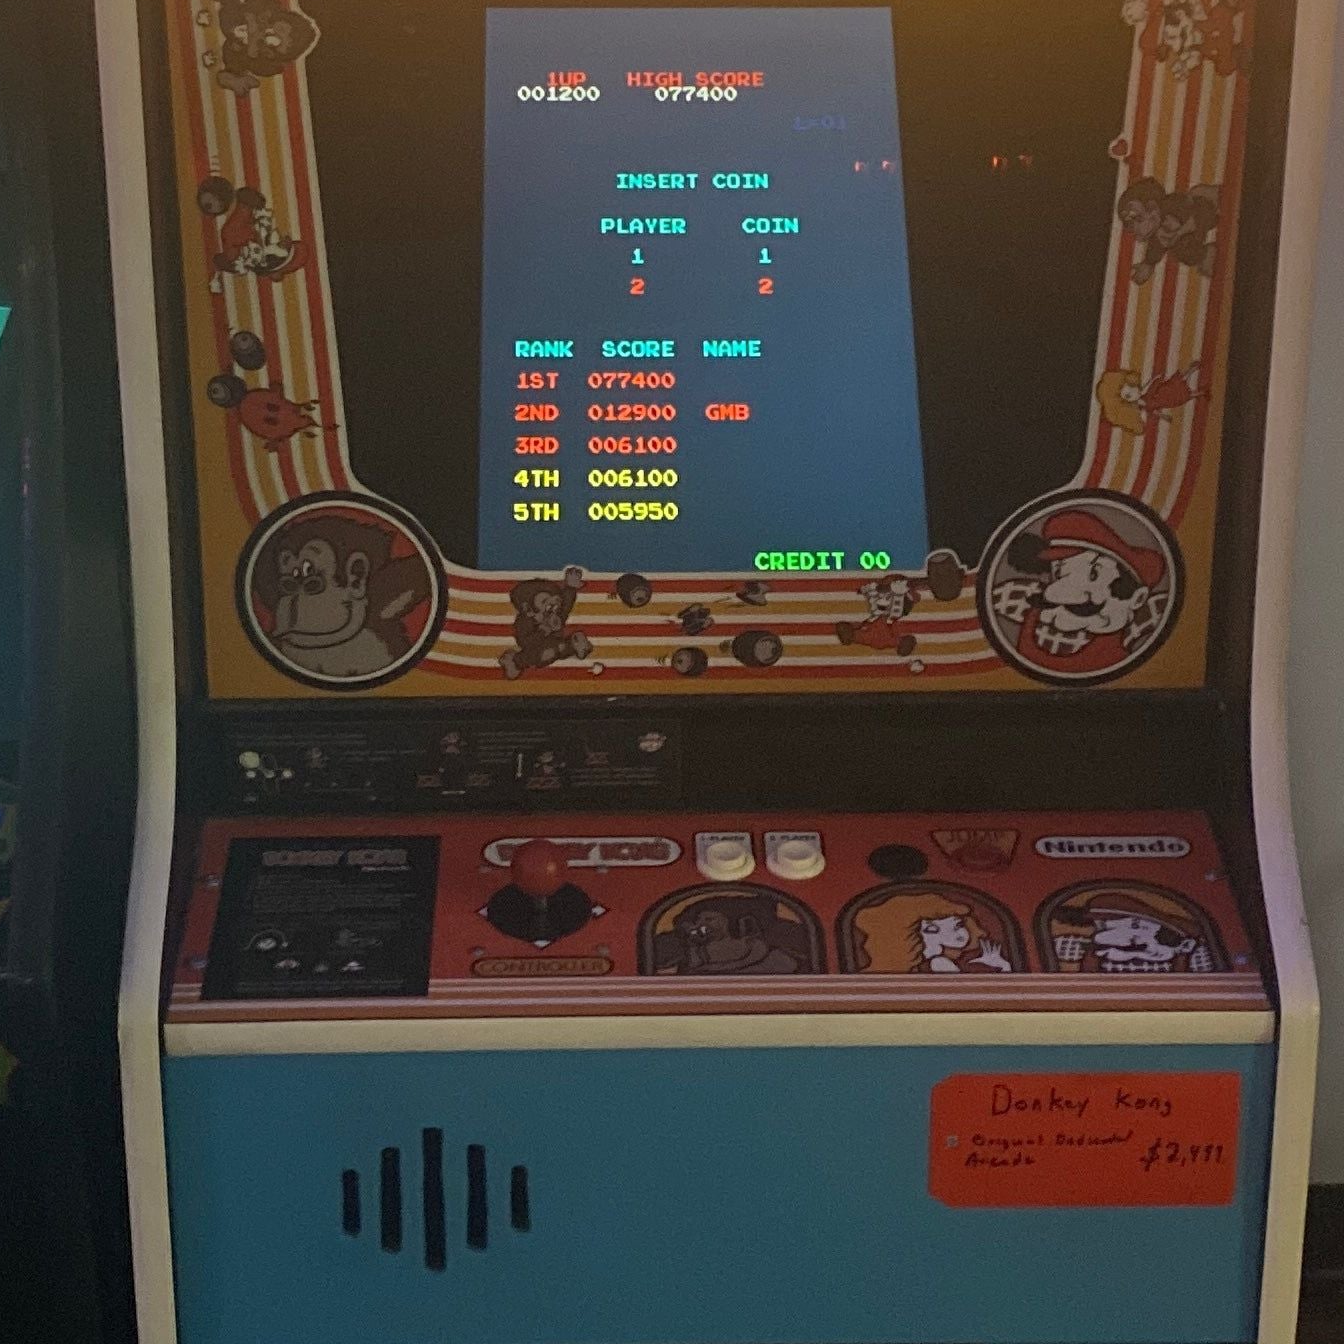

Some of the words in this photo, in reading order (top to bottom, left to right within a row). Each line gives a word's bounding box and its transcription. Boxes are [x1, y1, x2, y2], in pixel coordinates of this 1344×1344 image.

[546, 72, 587, 86] 1UP
[626, 72, 679, 87] HIGH
[695, 72, 764, 87] SCORE
[517, 86, 601, 102] 001200
[654, 86, 738, 102] 077400
[616, 173, 699, 189] INSERT
[712, 173, 769, 189] COIN
[600, 217, 686, 234] PLAYER
[742, 217, 799, 234] COIN
[631, 248, 645, 265] 1
[758, 248, 772, 264] 1
[629, 278, 645, 295] 2
[758, 278, 774, 295] 2
[514, 340, 574, 358] RANK
[601, 340, 676, 358] SCORE
[702, 340, 762, 358] NAME
[517, 372, 559, 389] 1ST
[587, 372, 676, 389] 077400
[514, 404, 560, 421] 2ND
[587, 404, 677, 421] 012900
[704, 403, 751, 422] GMB
[514, 437, 560, 454] 3RD
[587, 437, 677, 454] 006100
[513, 469, 560, 488] 4TH
[587, 469, 679, 487] 006100
[513, 502, 560, 522] 5TH
[587, 501, 679, 521] 005950
[754, 552, 846, 571] CREDIT
[859, 551, 892, 570] 00
[1043, 839, 1185, 855] Nintendo
[991, 1083, 1090, 1118] Donkey
[1114, 1086, 1174, 1118] Kong
